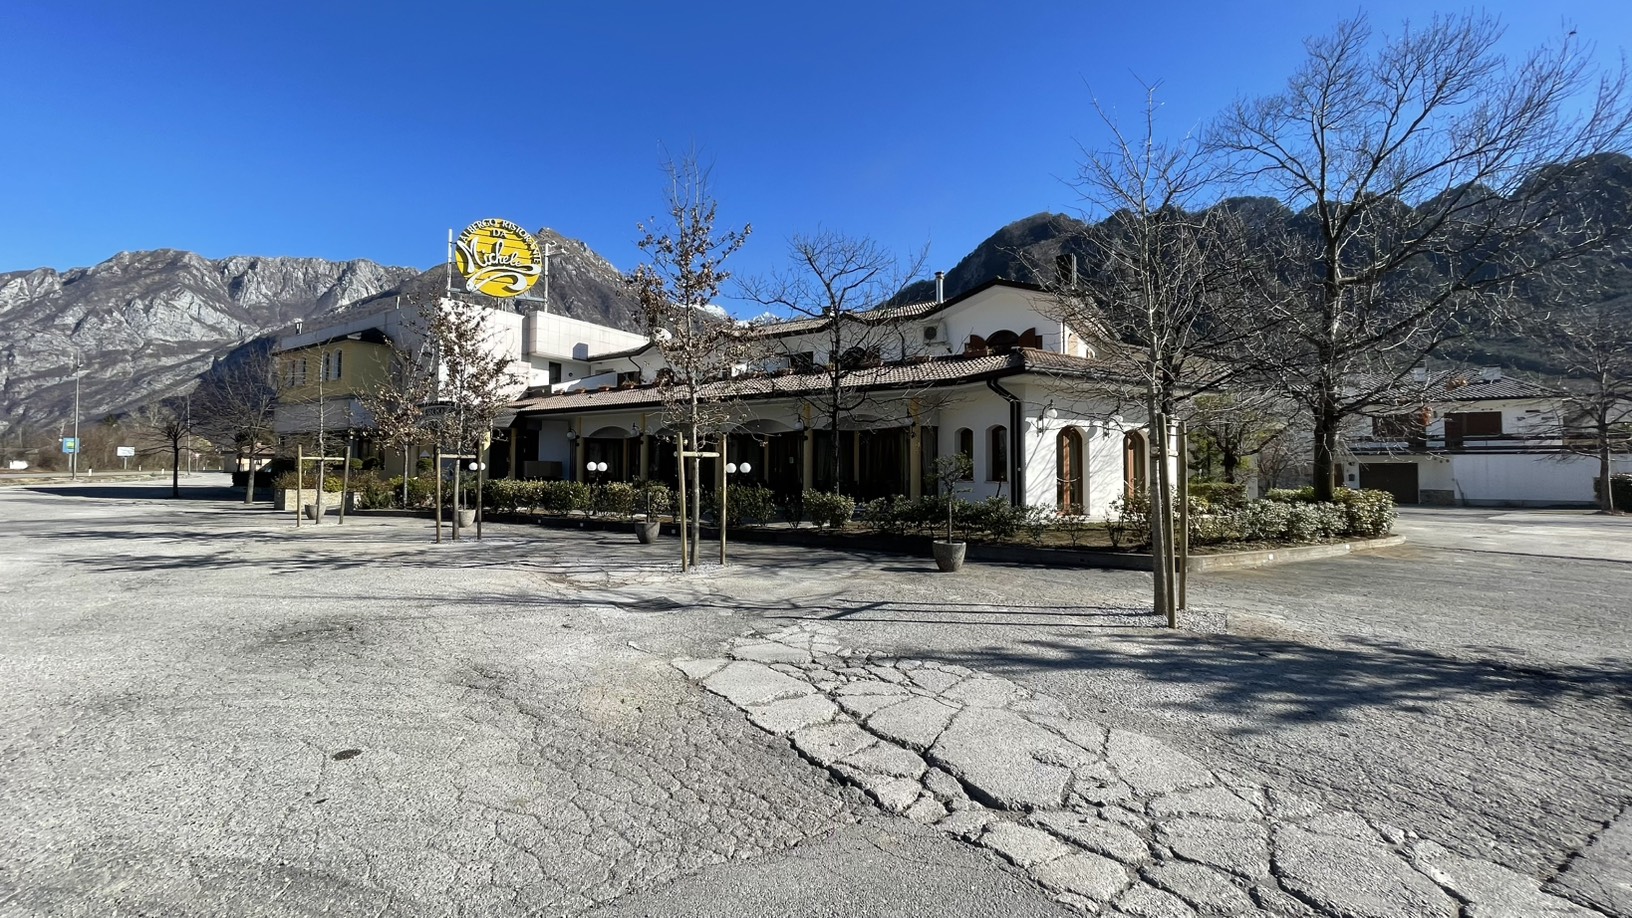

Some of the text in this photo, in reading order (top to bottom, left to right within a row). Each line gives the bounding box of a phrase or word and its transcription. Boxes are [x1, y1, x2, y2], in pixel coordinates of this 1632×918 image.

[461, 218, 497, 243] ALBERGO
[492, 229, 506, 239] DA
[456, 236, 523, 274] Michele
